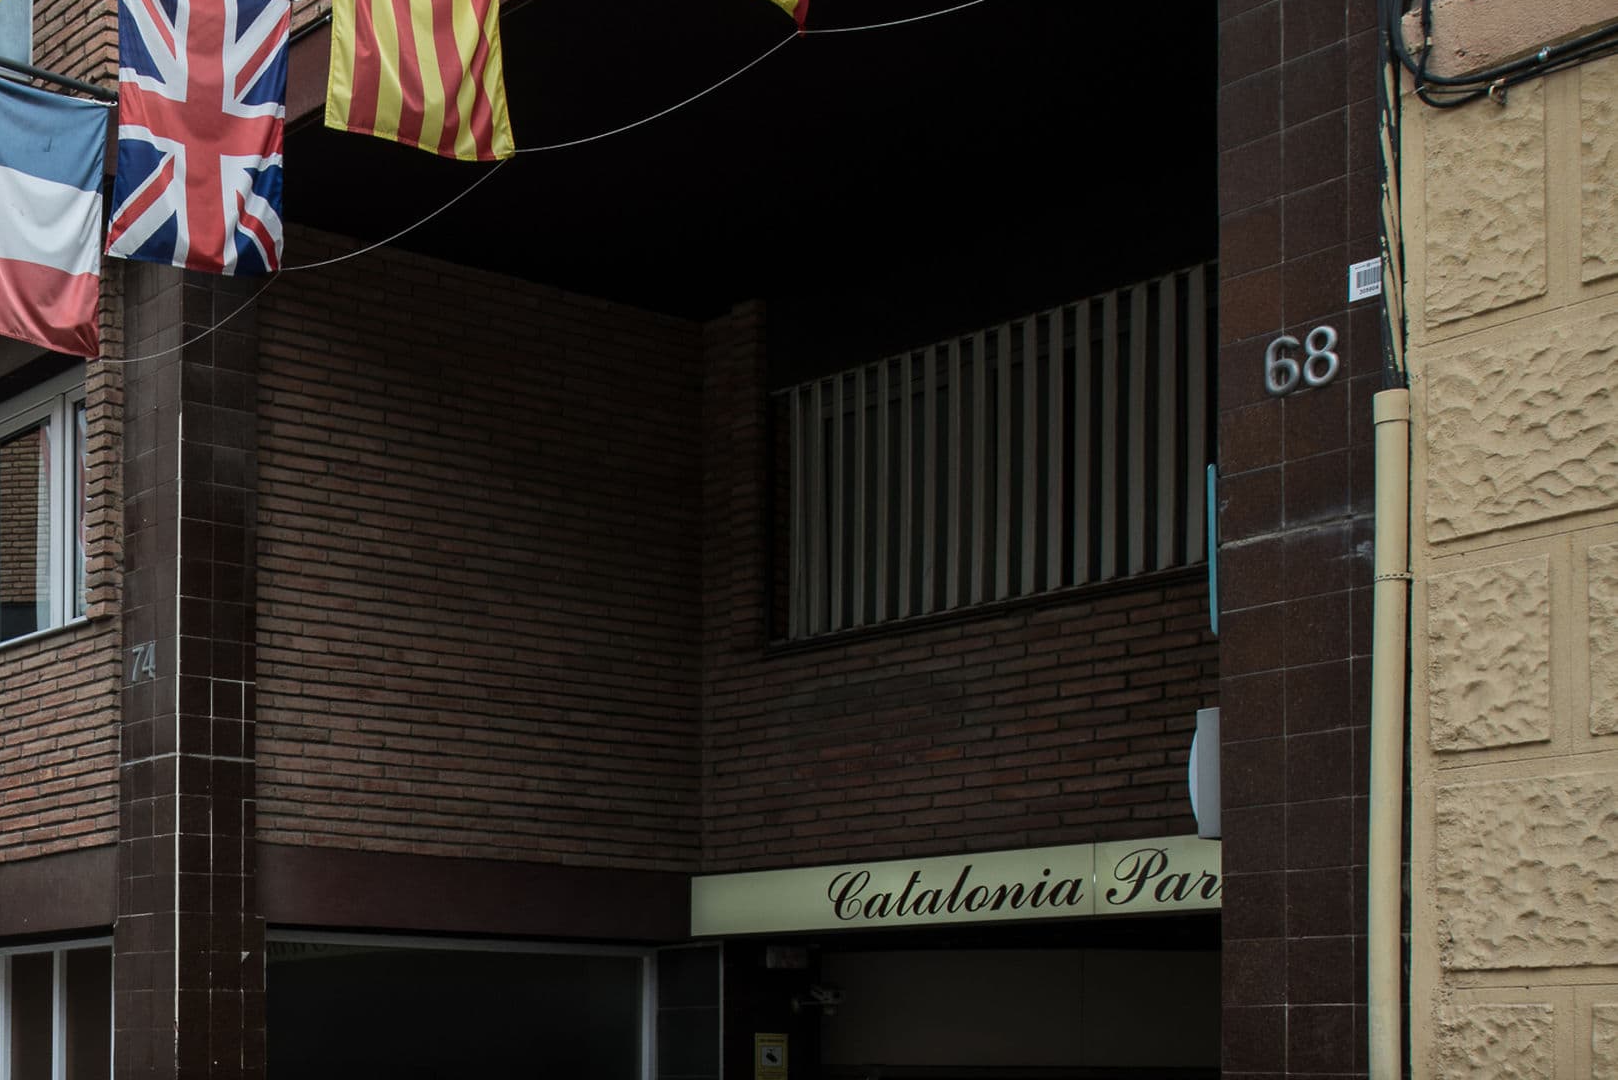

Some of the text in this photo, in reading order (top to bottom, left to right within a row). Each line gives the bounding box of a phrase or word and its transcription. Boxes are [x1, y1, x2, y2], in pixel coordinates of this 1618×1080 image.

[1265, 325, 1339, 395] 68
[132, 640, 156, 681] 74
[828, 848, 1222, 921] Catalonia Par
